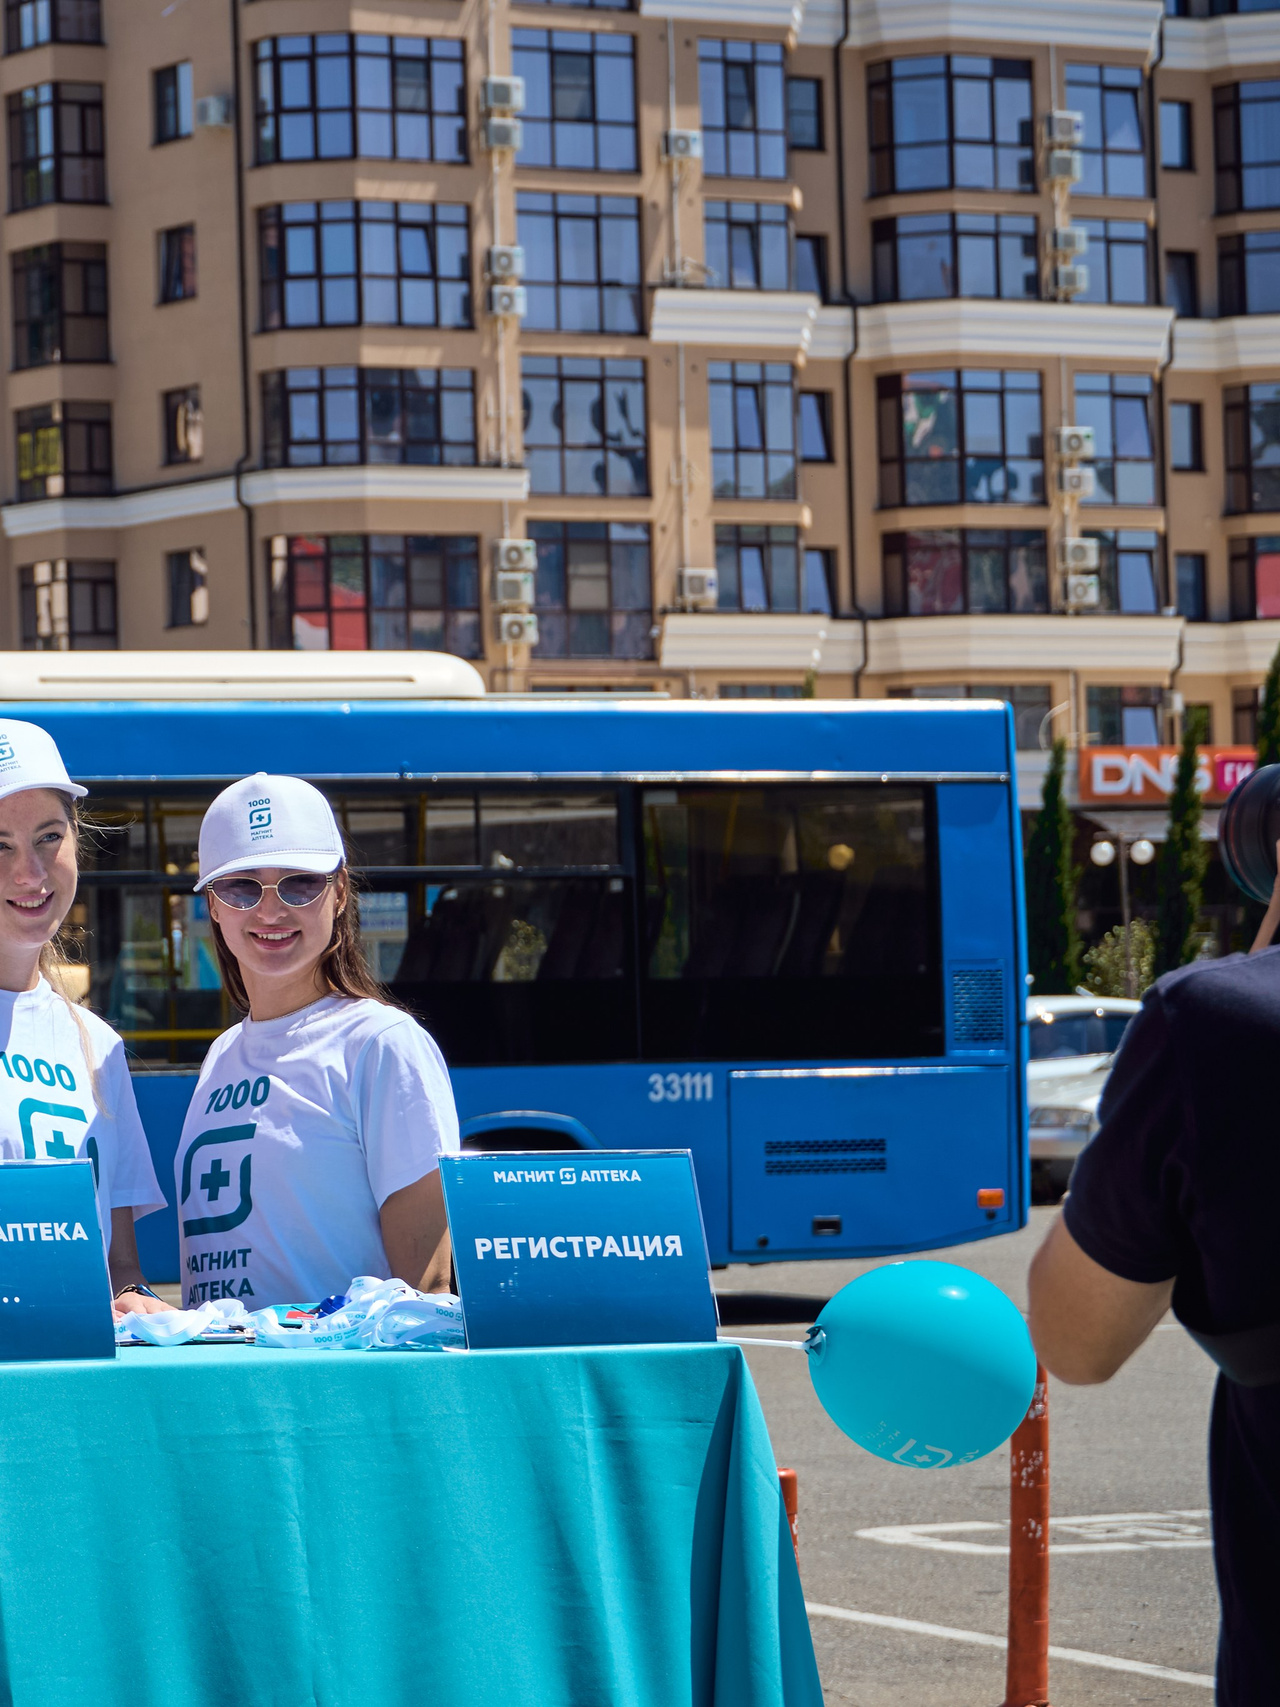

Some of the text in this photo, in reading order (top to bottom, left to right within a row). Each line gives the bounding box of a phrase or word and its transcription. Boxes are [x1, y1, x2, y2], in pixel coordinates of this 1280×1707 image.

[248, 798, 271, 808] 1000
[205, 1075, 270, 1115] 1000
[648, 1072, 713, 1103] 33111
[492, 1169, 642, 1184] МАГНИТ АПТЕКА
[474, 1234, 684, 1261] РЕГИСТРАЦИЯ
[187, 1277, 256, 1306] АПТЕКА
[435, 1307, 455, 1319] 1000
[313, 1335, 333, 1343] 1000
